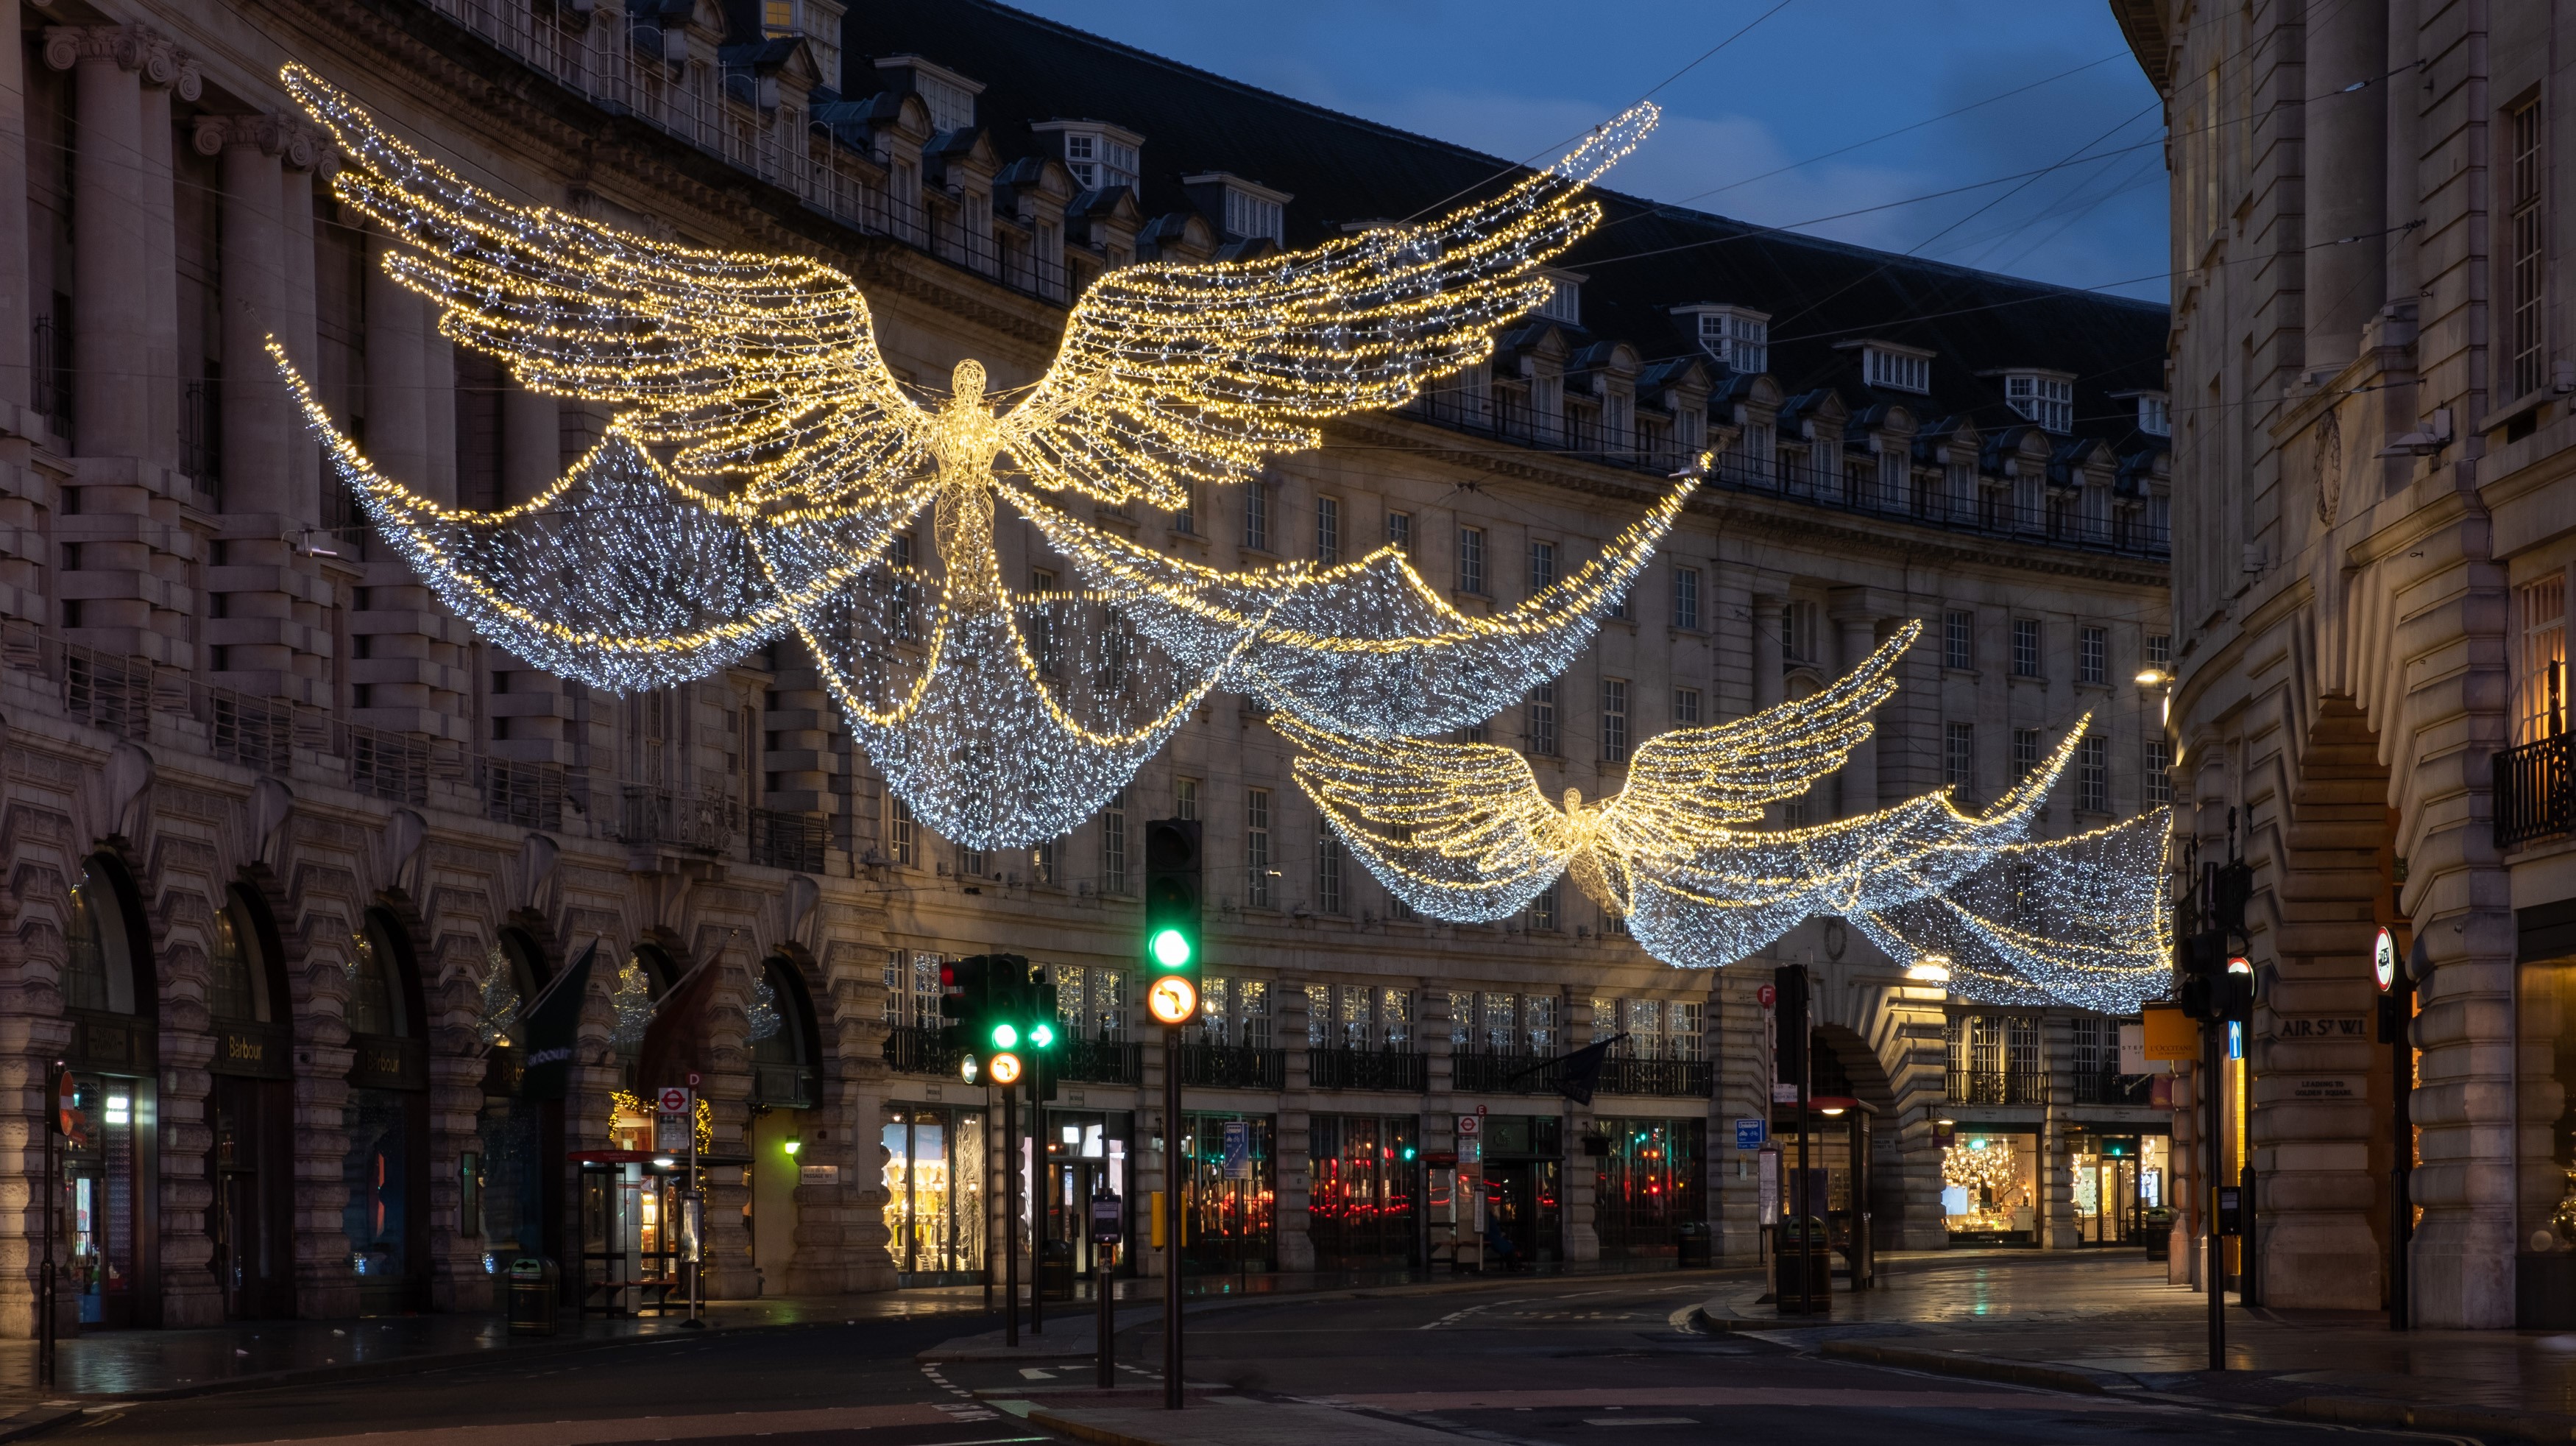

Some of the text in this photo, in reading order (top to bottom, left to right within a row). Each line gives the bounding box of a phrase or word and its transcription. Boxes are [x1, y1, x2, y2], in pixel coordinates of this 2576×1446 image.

[1762, 988, 1772, 1003] F
[2281, 1020, 2313, 1037] AIR
[228, 1035, 263, 1060] Barbour
[366, 1050, 400, 1073] Barbour
[528, 1047, 572, 1068] arbour
[501, 1060, 525, 1083] Barbo
[690, 1073, 700, 1085] D
[1478, 1106, 1484, 1115] E
